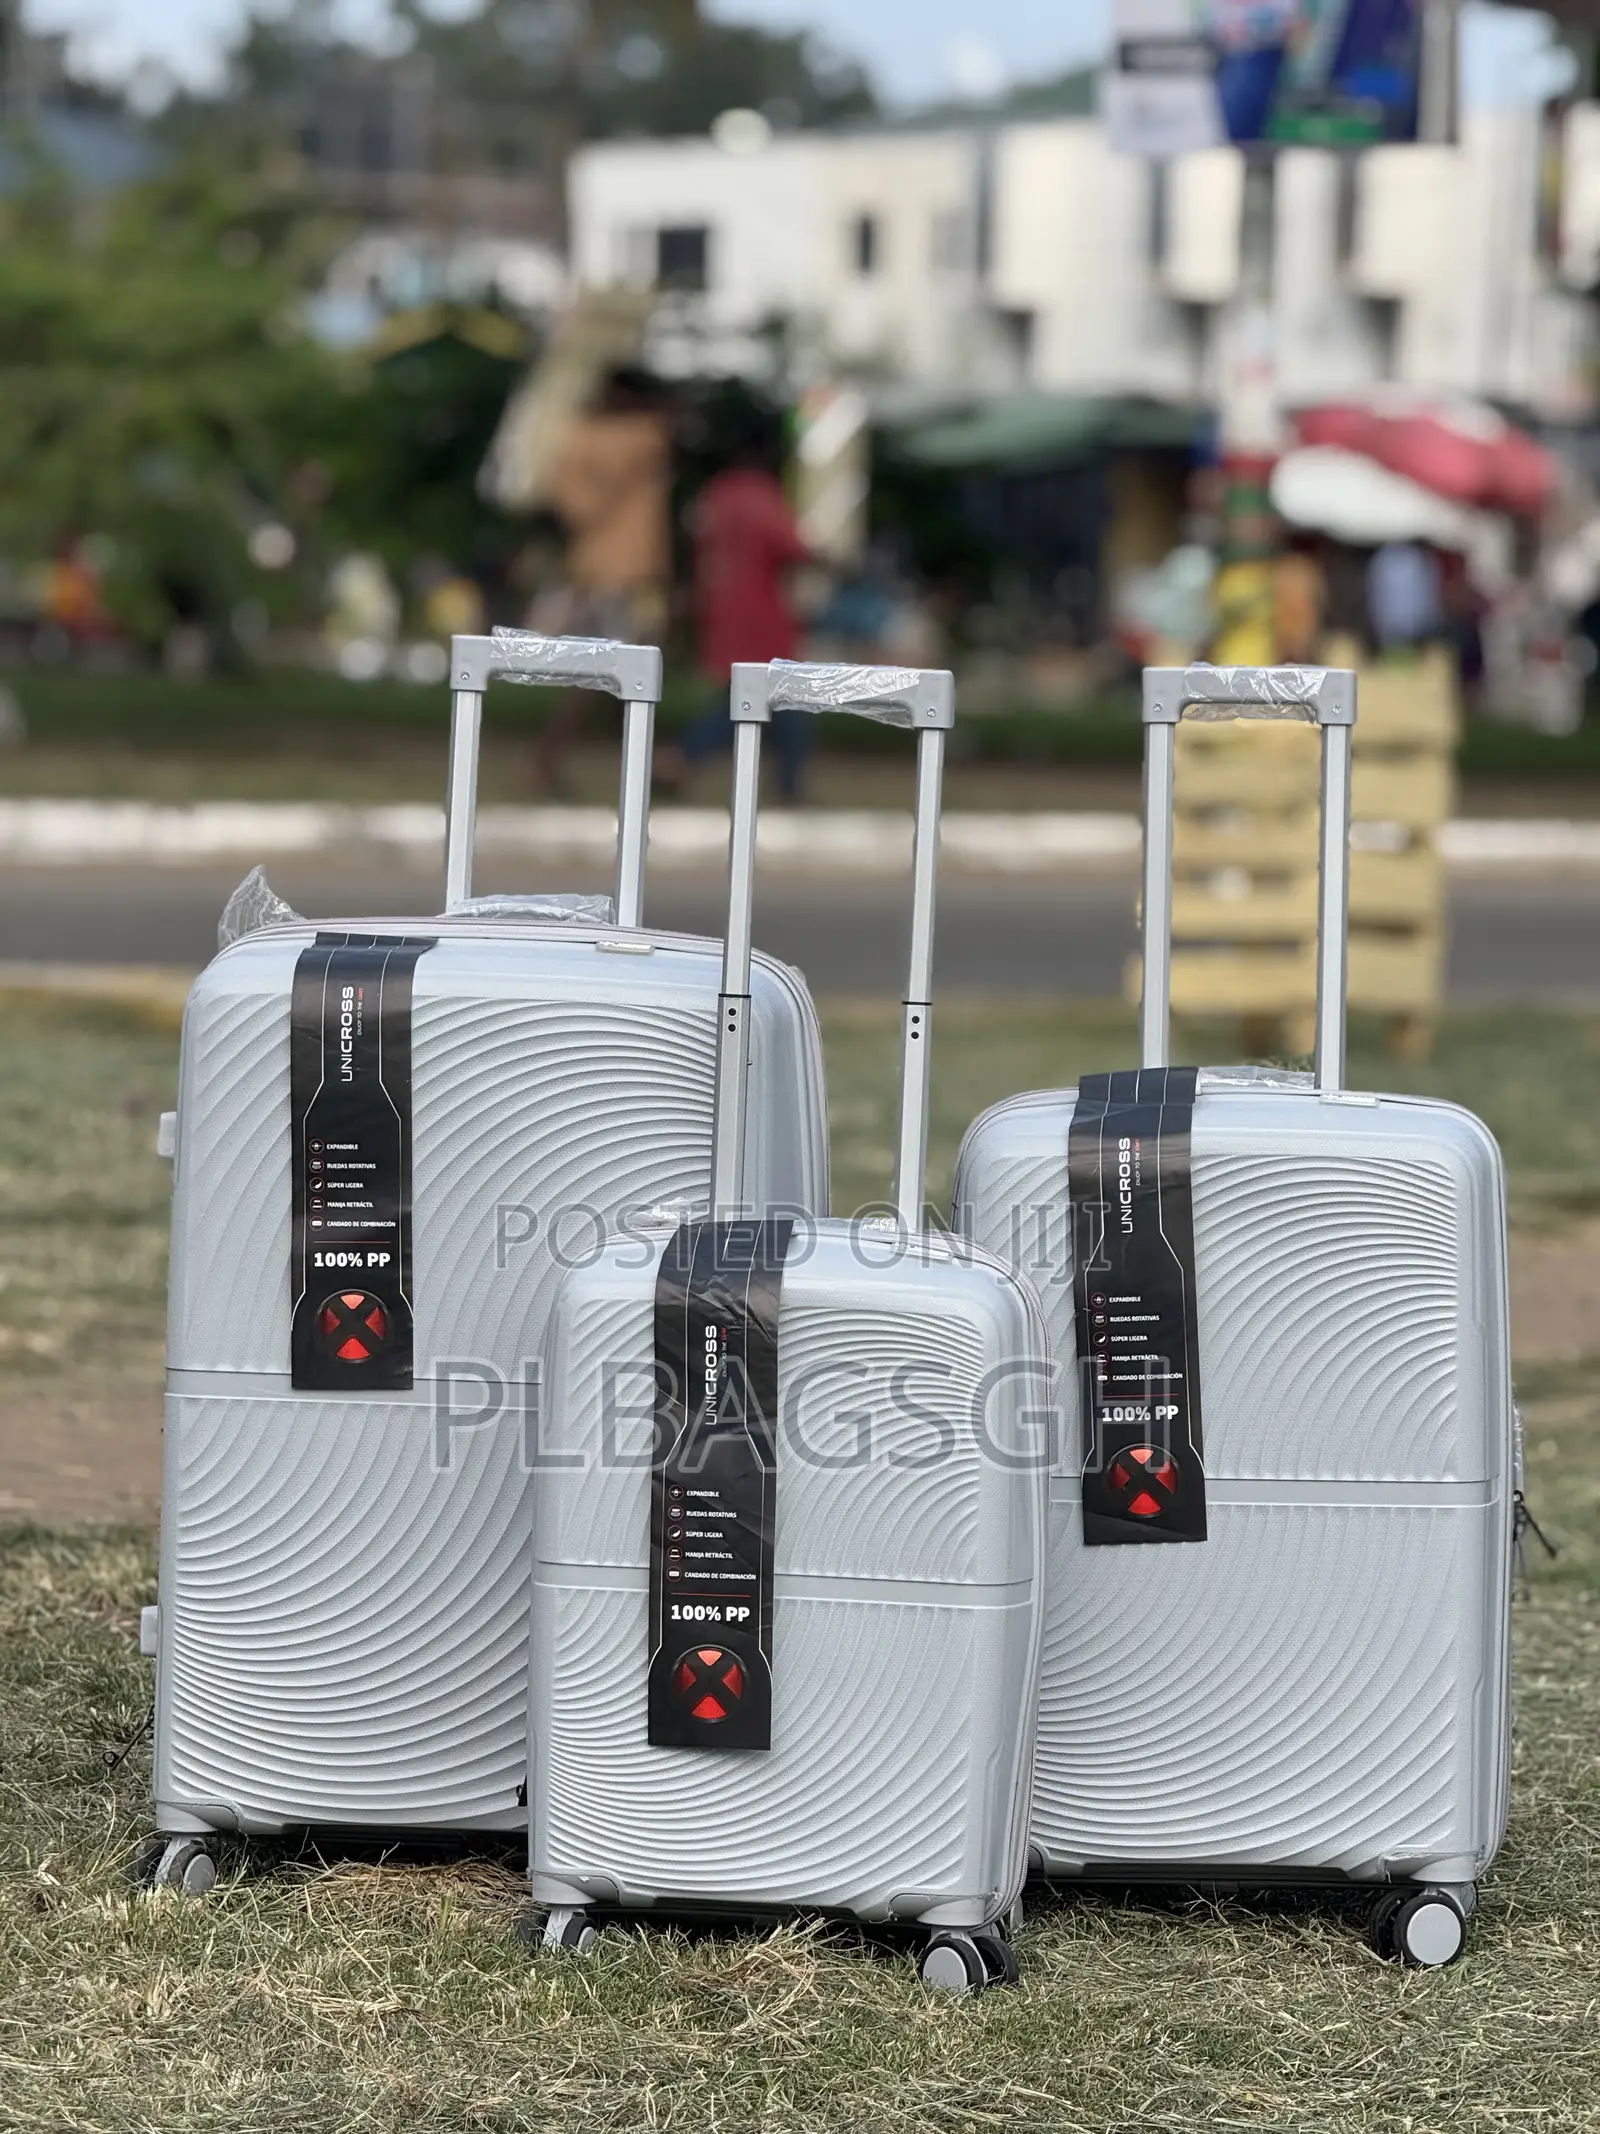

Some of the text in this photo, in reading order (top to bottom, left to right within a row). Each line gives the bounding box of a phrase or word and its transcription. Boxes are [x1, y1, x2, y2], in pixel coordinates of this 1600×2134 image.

[340, 986, 354, 1082] UNICROSS
[1118, 1137, 1133, 1234] UNICROSS
[327, 1201, 346, 1209] MANIJA
[314, 1252, 391, 1268] 100% PP
[705, 1325, 718, 1426] UNICROSS
[1102, 1405, 1179, 1422] 100% PP
[685, 1551, 704, 1559] MANIJA
[671, 1604, 750, 1622] 100% PP
